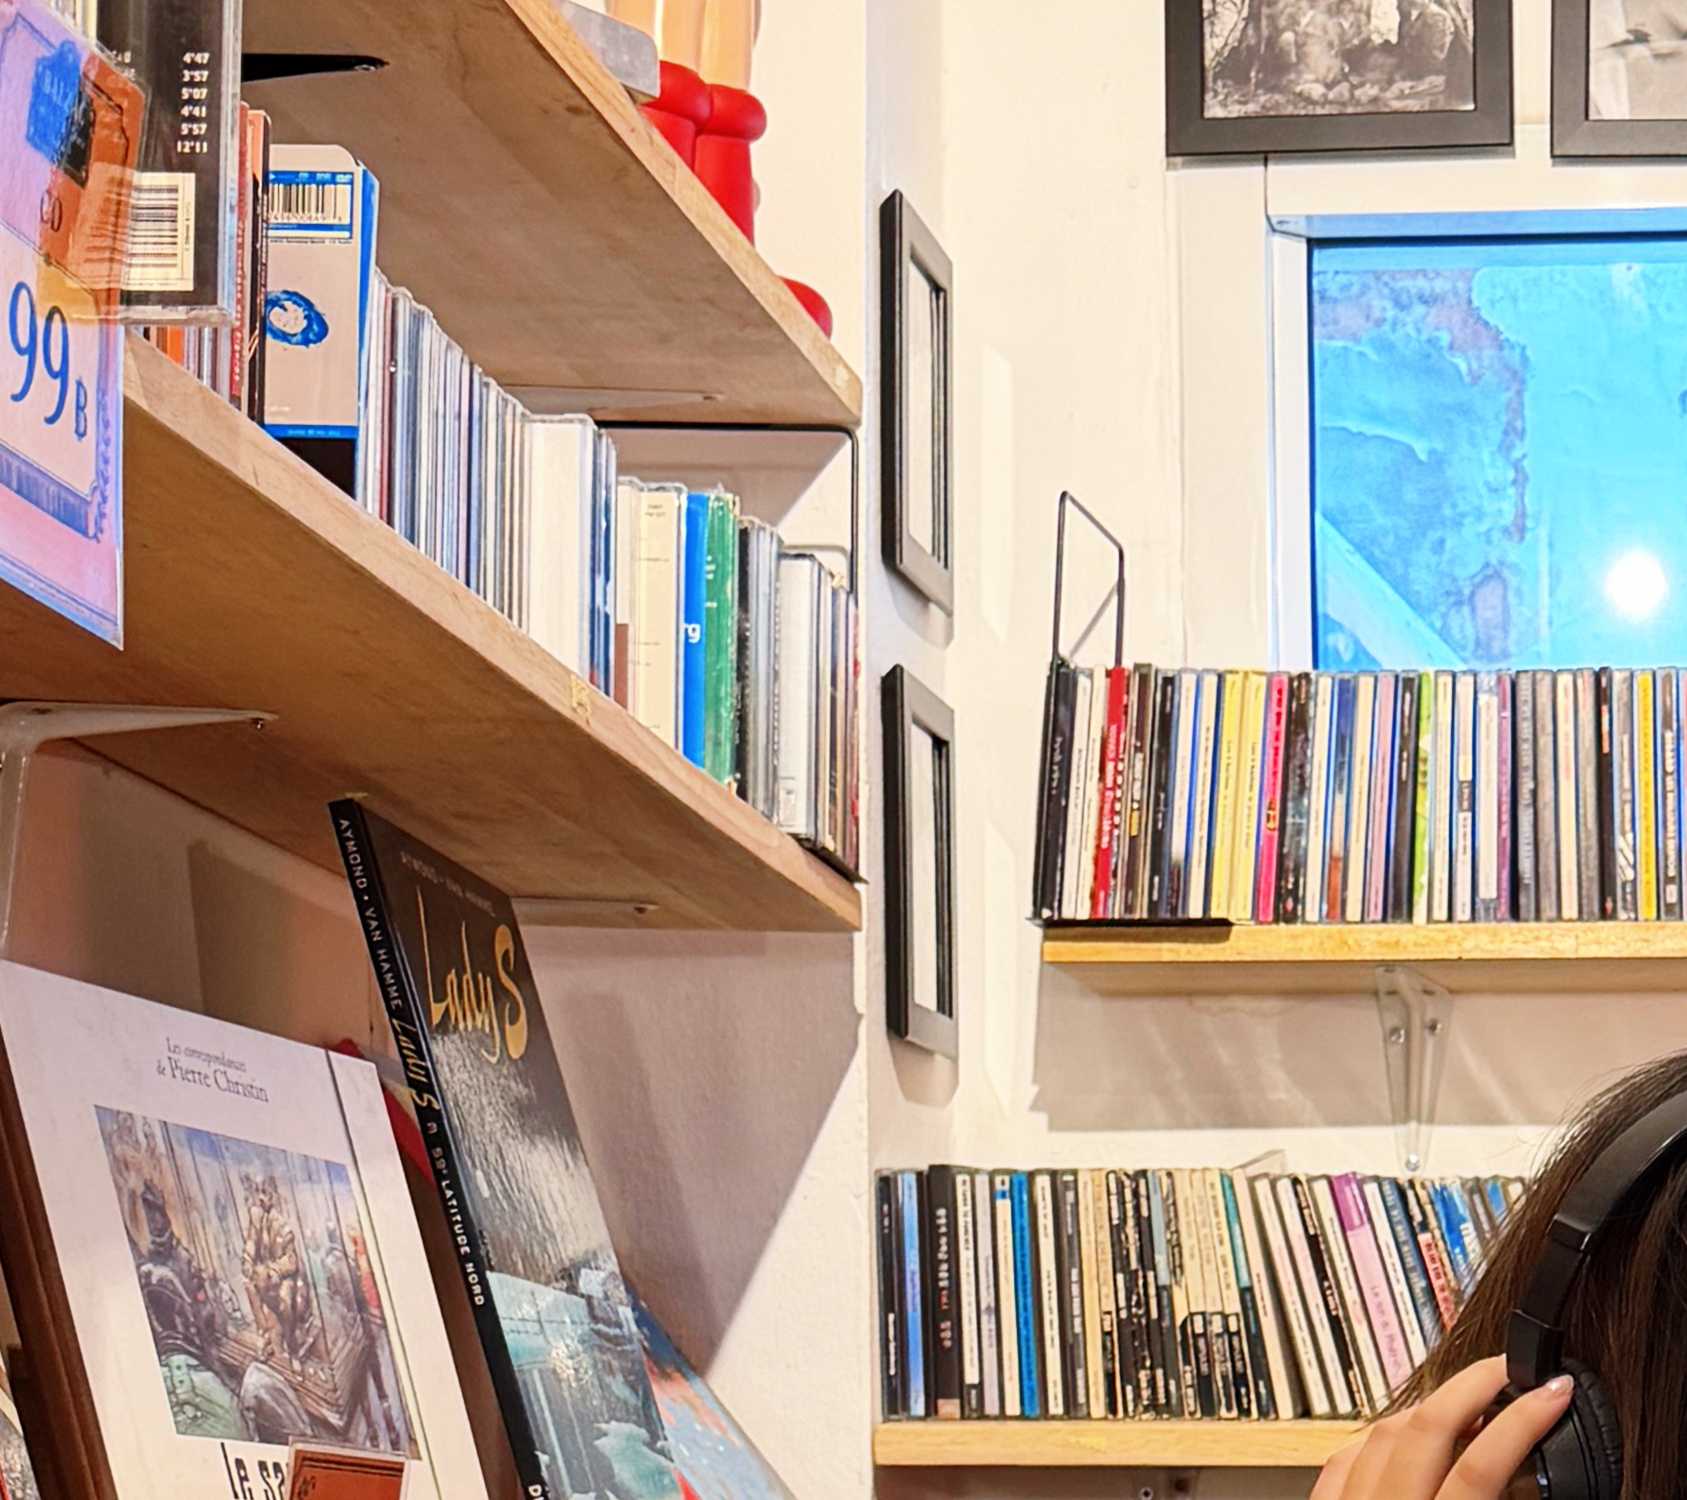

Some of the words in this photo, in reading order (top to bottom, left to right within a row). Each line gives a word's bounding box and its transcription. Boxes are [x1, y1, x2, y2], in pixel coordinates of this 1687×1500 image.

[339, 819, 368, 889] AYMOND
[364, 907, 383, 941] VAN
[377, 948, 403, 1010] HAMME
[441, 1180, 472, 1256] LATITUDE
[464, 1261, 485, 1306] NORD
[416, 885, 501, 1065] Lady
[494, 923, 529, 1060] S
[167, 1056, 212, 1088] Pierre
[213, 1068, 269, 1103] Christin
